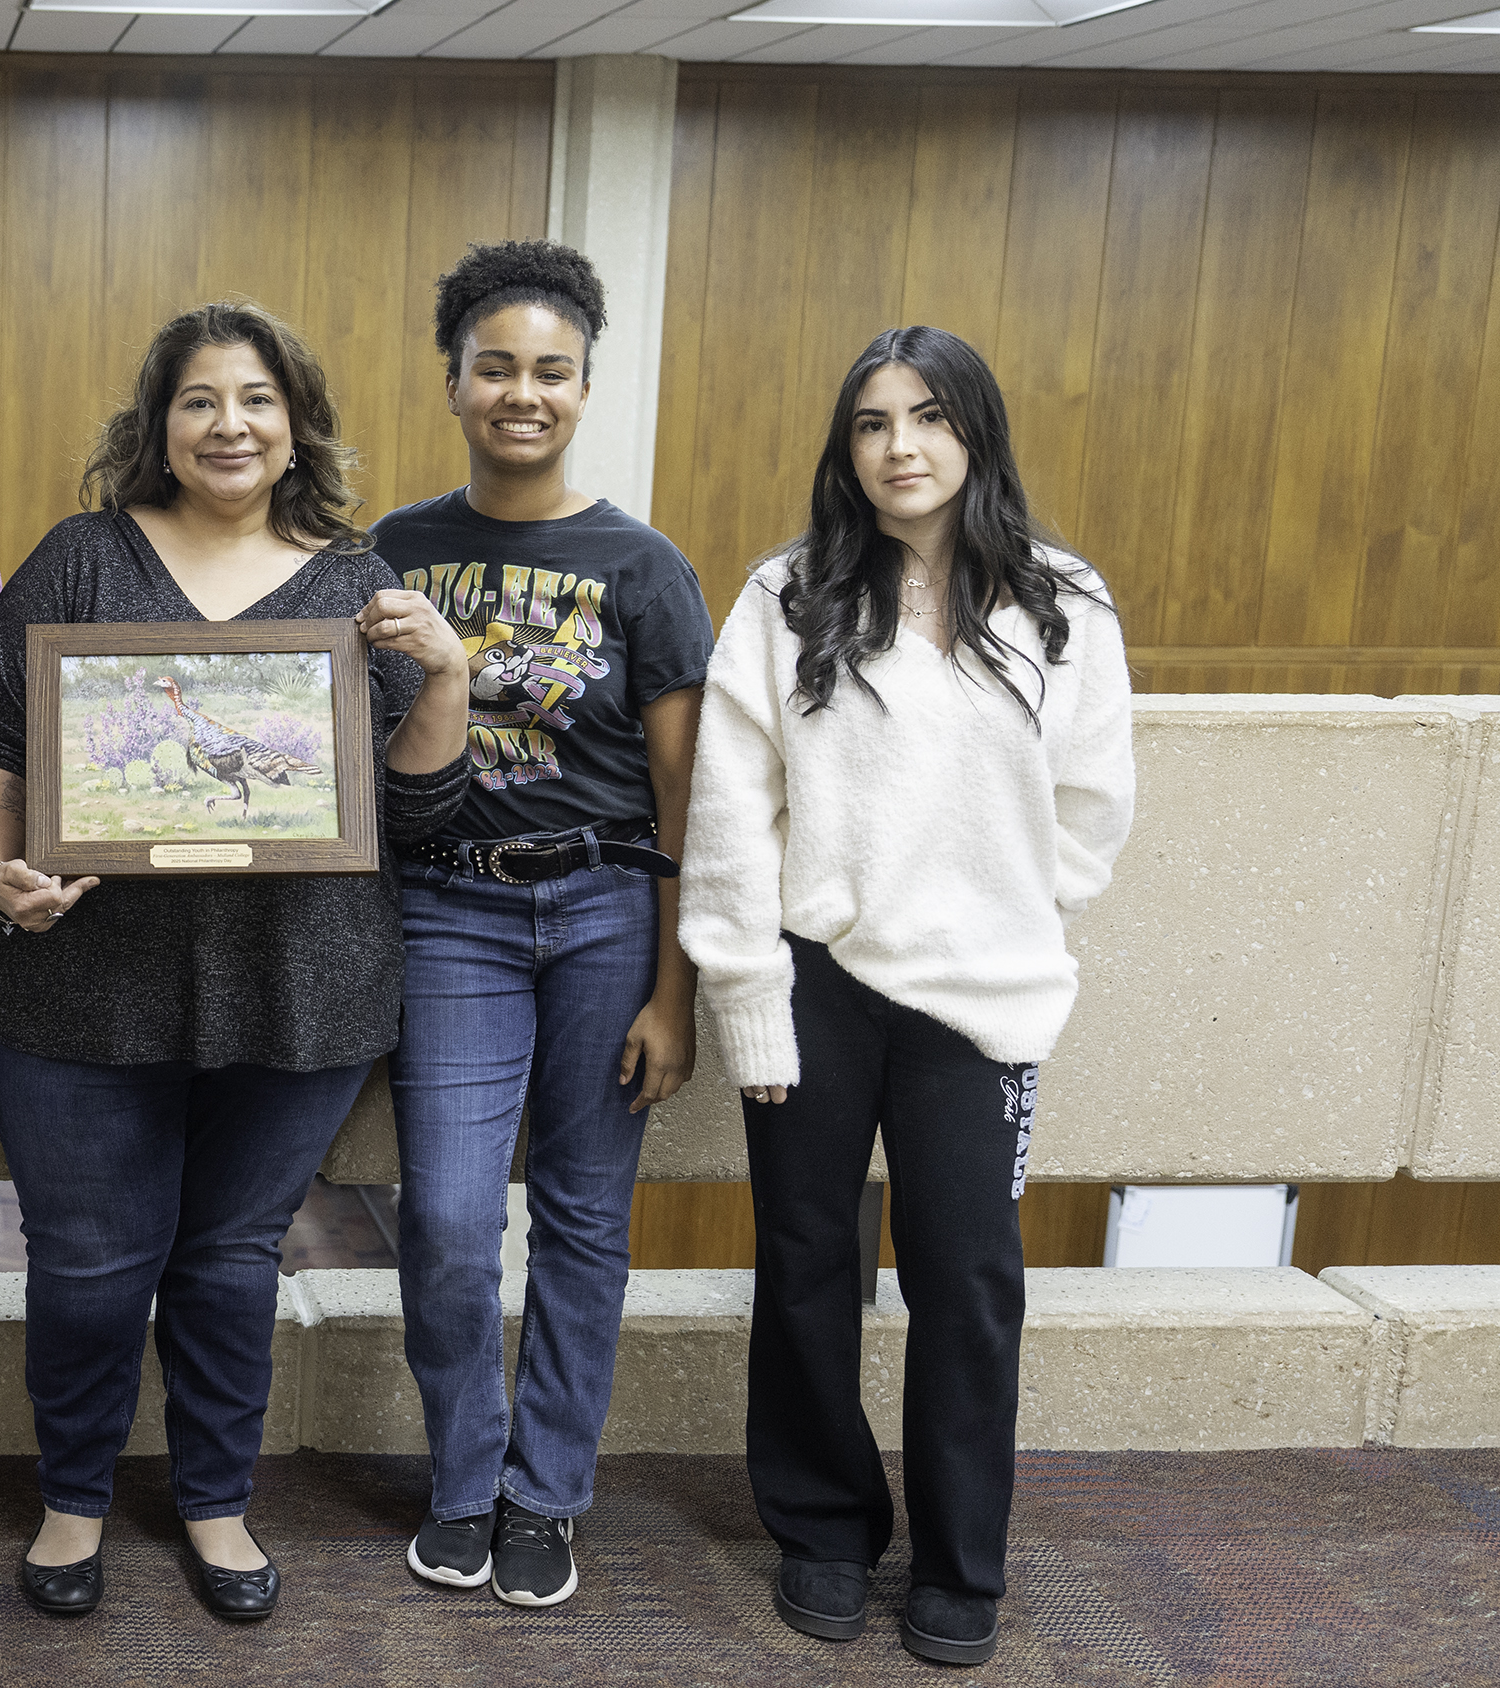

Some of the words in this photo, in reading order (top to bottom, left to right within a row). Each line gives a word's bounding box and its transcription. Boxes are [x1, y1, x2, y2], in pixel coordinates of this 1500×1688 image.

[540, 647, 588, 669] BELIEVER
[492, 714, 515, 722] 1982
[468, 725, 558, 769] OUR
[472, 763, 562, 791] 82-2022
[1000, 1075, 1019, 1124] York
[1010, 1062, 1039, 1201] OSTALE
